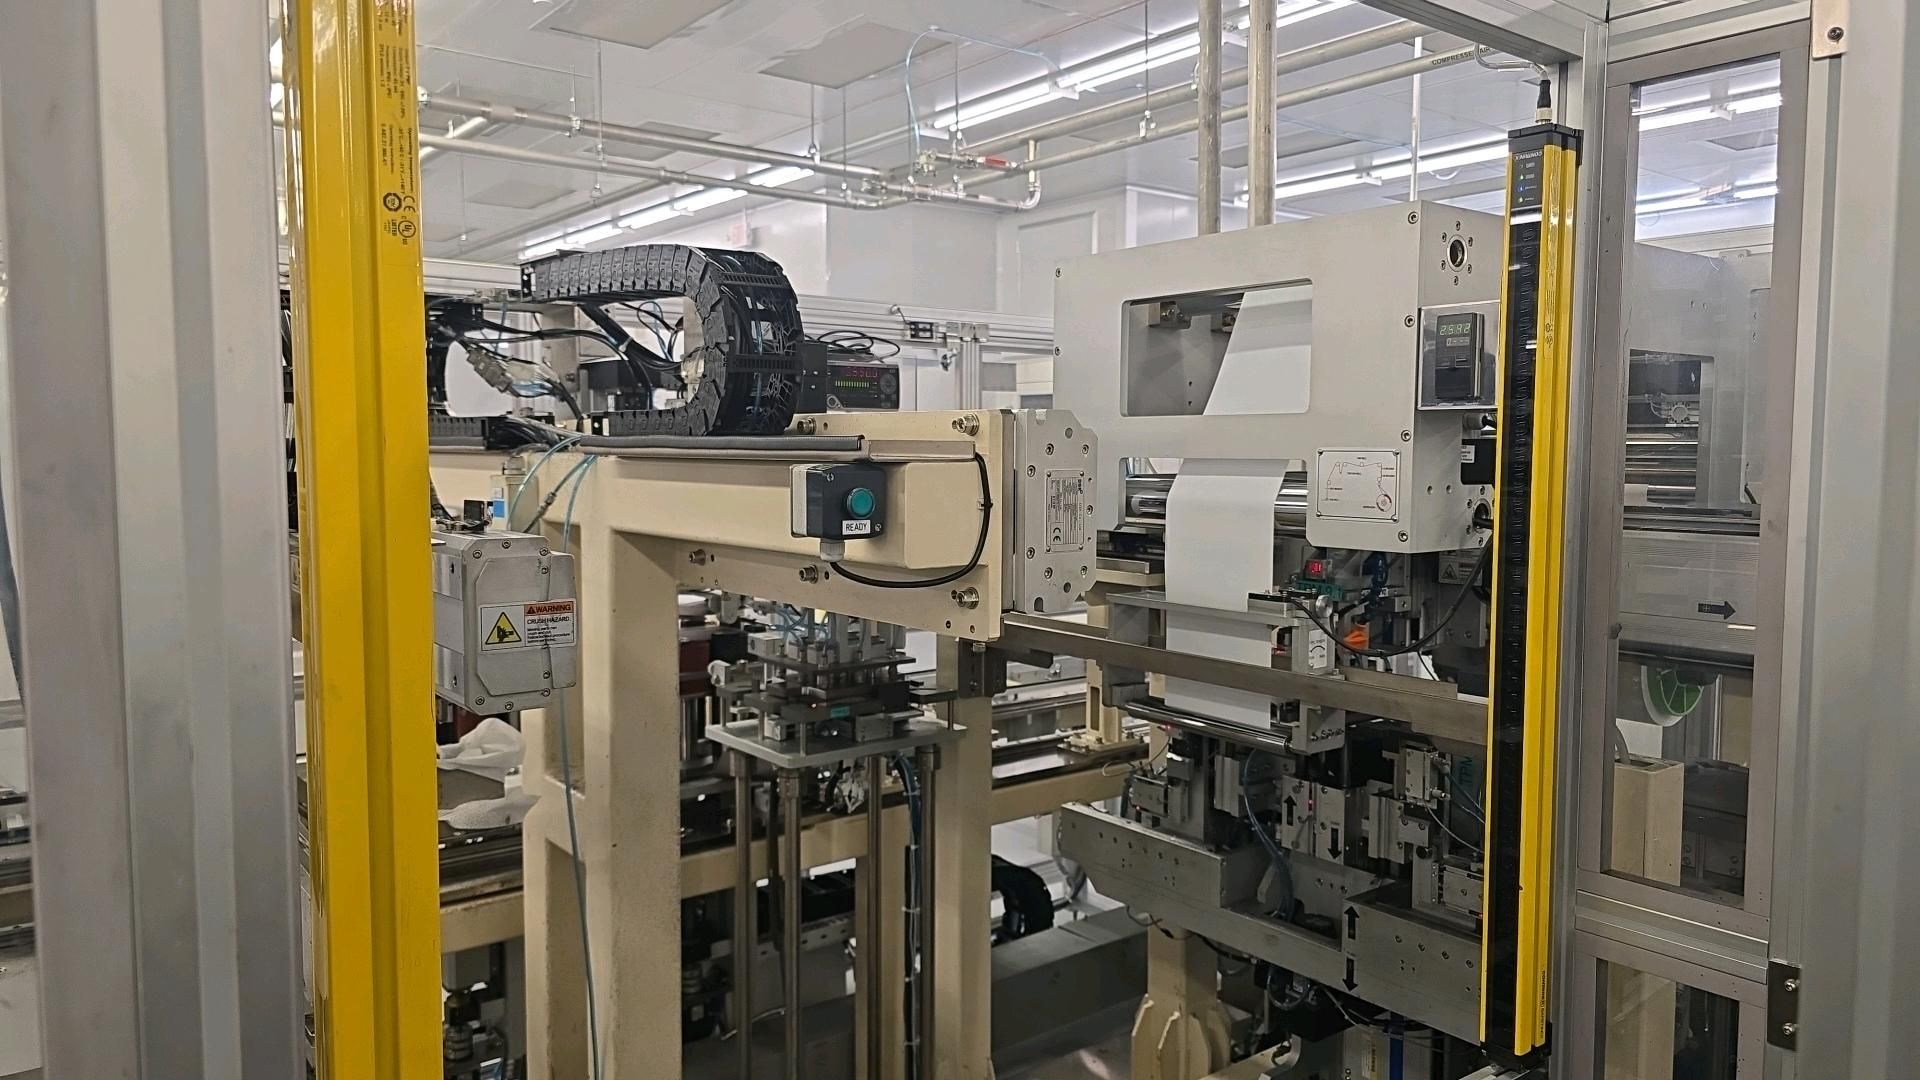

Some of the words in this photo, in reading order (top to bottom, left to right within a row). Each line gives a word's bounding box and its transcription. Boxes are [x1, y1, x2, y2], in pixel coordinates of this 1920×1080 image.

[1431, 51, 1476, 66] COMPRESSE
[845, 523, 867, 532] READY
[535, 604, 571, 613] WARNING
[527, 617, 547, 625] CRUSH
